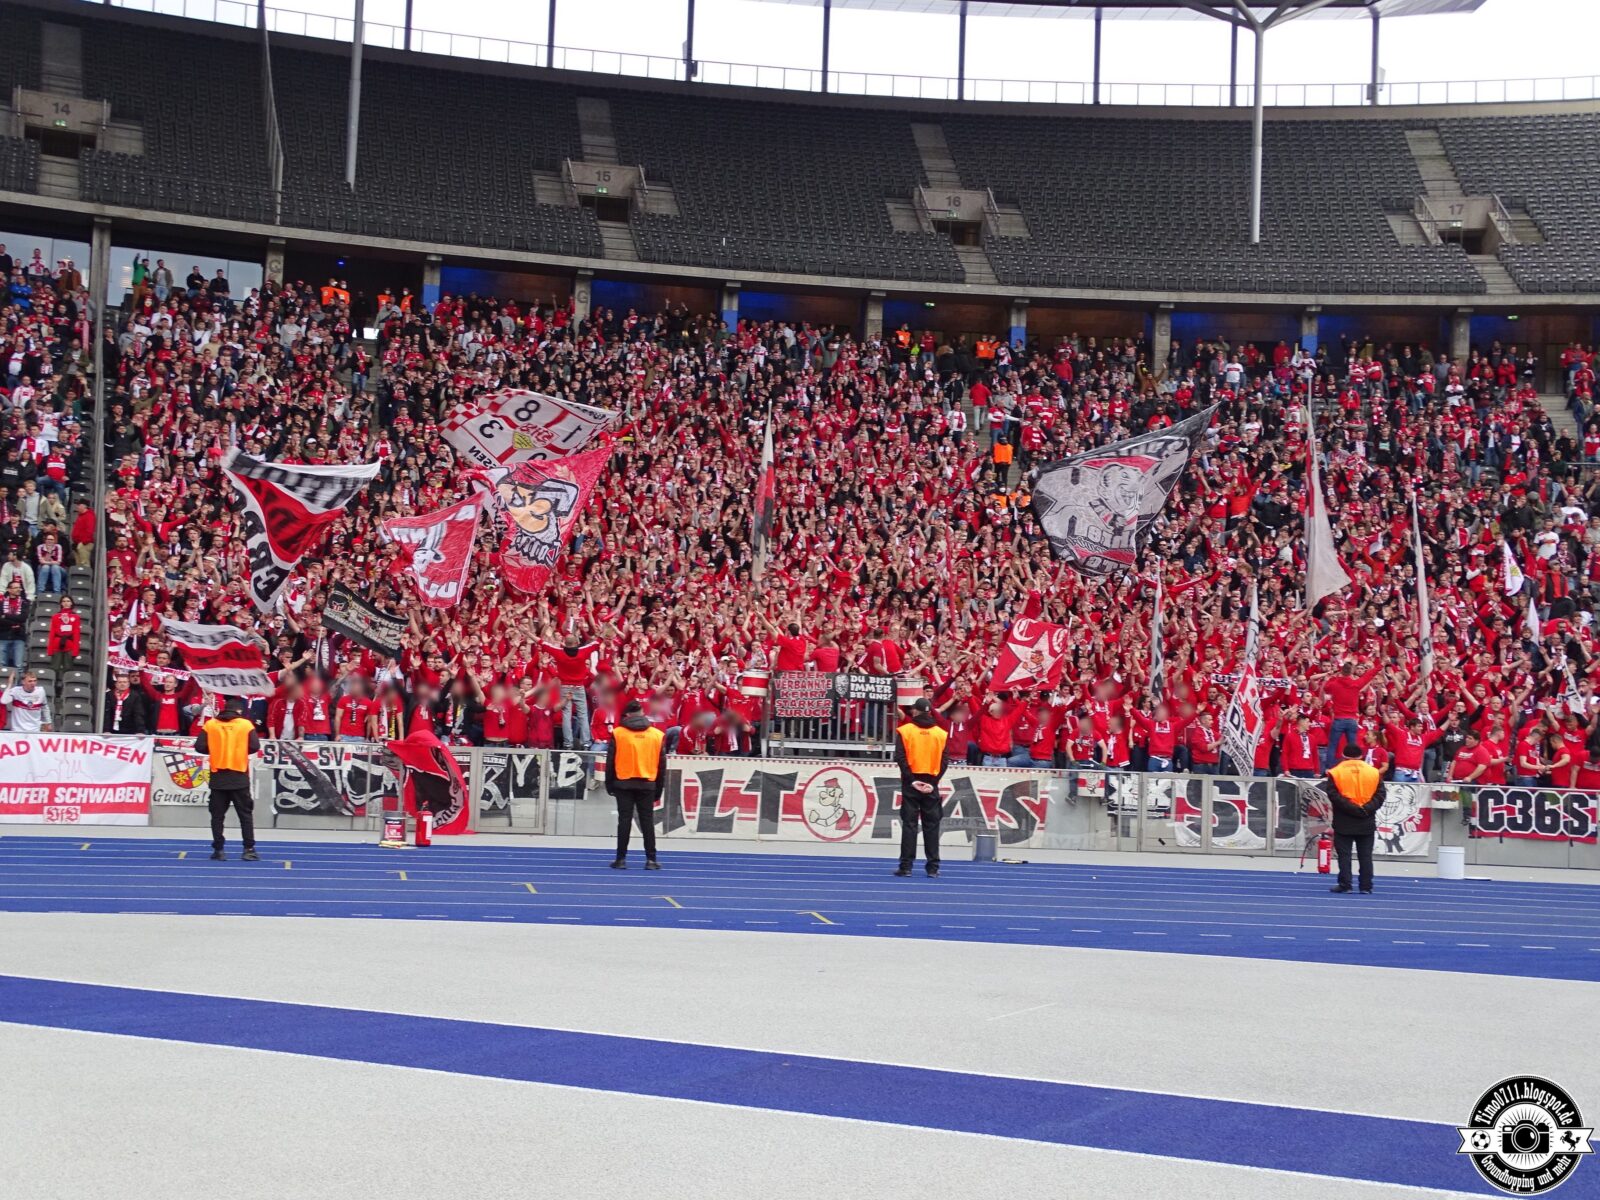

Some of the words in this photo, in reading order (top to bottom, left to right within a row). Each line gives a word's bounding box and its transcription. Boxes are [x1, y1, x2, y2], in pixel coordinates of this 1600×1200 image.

[52, 102, 71, 115] 14
[595, 170, 611, 182] 15
[945, 195, 962, 207] 16
[1448, 203, 1464, 215] 17
[781, 671, 827, 679] JEDER
[850, 675, 866, 683] DU
[869, 676, 893, 685] BIST
[774, 679, 832, 690] VERBANNTE
[850, 683, 892, 693] IMMER
[780, 690, 828, 699] KEHRT
[869, 692, 893, 700] UNS!
[39, 737, 147, 765] WIMPFEN
[54, 786, 147, 804] SCHWABEN
[1477, 787, 1592, 838] C36S
